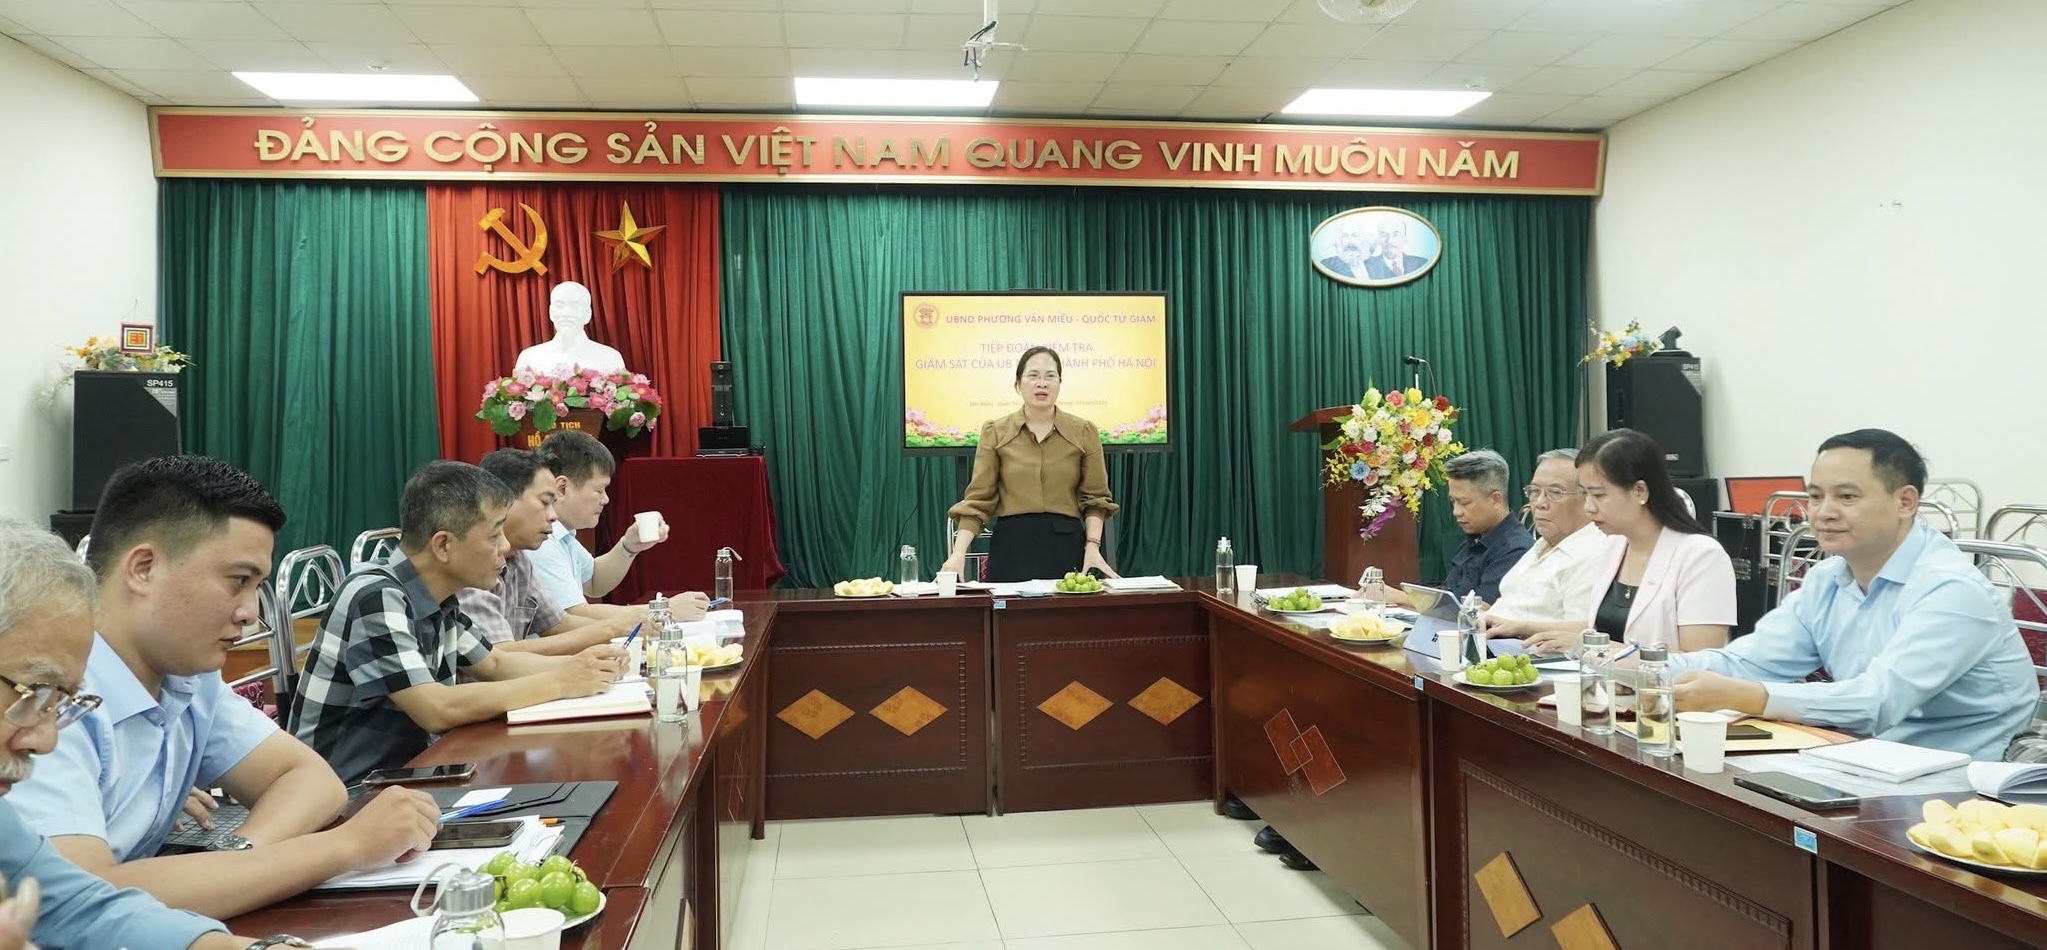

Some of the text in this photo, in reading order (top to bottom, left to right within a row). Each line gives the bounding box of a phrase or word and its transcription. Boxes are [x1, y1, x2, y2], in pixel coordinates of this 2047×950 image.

[254, 116, 1520, 179] ĐẢNG CỘNG SẢN VIỆT NAM QUANG VINH MUÔN NĂM
[946, 315, 975, 324] UBND
[1072, 343, 1093, 353] TRA
[997, 359, 1012, 368] UB
[146, 379, 174, 387] SP415
[560, 421, 581, 430] TỊCH
